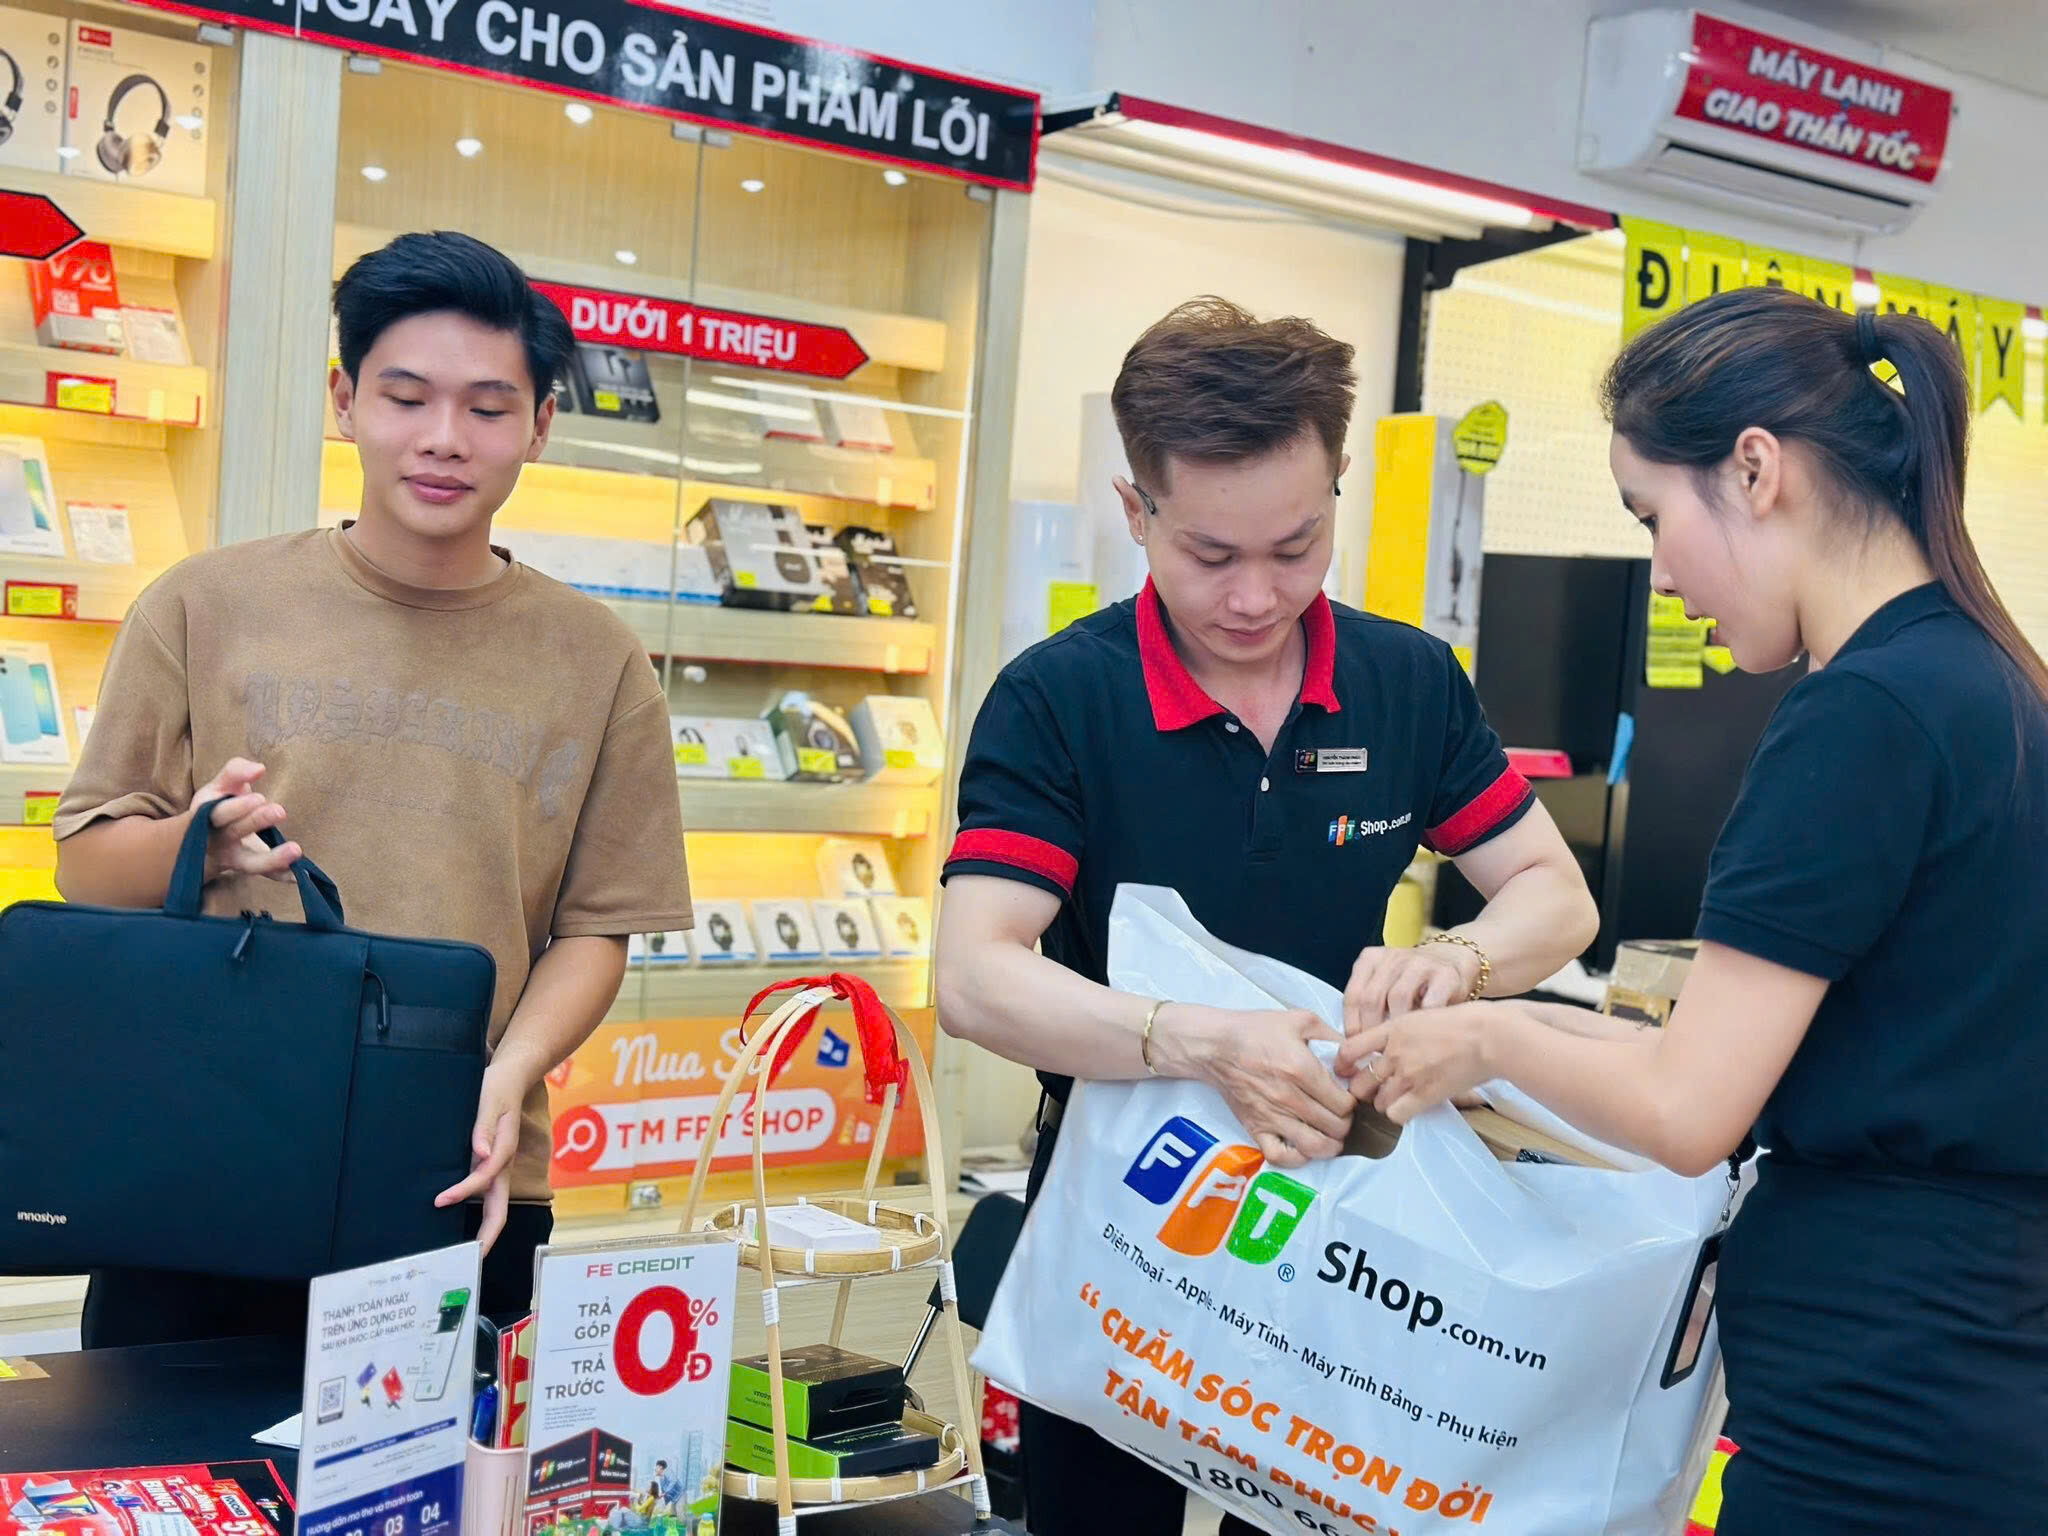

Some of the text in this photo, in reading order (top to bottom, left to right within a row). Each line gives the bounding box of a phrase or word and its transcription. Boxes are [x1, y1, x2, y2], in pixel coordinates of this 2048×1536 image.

[475, 0, 605, 75] CHO
[621, 30, 735, 104] SẢN
[911, 96, 990, 161] LỖI
[1748, 45, 1820, 90] MÁY
[1704, 88, 1782, 132] GIAO
[571, 297, 798, 366] DƯỚI 1 TRIỆU
[1328, 819, 1356, 842] FPT
[611, 1033, 705, 1087] Mua
[676, 1113, 733, 1141] FPT
[741, 1107, 825, 1137] SHOP
[1135, 1128, 1301, 1243] FPT
[586, 1256, 695, 1279] FE CREDIT
[323, 1305, 355, 1322] THANH
[385, 1291, 410, 1306] NGAY
[398, 1305, 417, 1320] EVO
[578, 1296, 613, 1318] TRẢ
[1316, 1241, 1548, 1370] Shop.com.vn
[574, 1321, 611, 1340] GÓP
[1102, 1222, 1130, 1255] Điện
[1130, 1242, 1165, 1284] Thoại
[1219, 1305, 1254, 1335] Máy
[1257, 1321, 1289, 1353] Tính
[1301, 1347, 1336, 1378] Máy
[1339, 1365, 1377, 1395] Tính
[1380, 1383, 1424, 1422] Bảng
[1437, 1410, 1474, 1442] Phụ
[1479, 1425, 1518, 1450] kiện
[571, 1353, 606, 1375] TRẢ
[545, 1379, 605, 1399] TRƯỚC
[1101, 1308, 1196, 1389] CHĂM
[1193, 1373, 1282, 1433] SÓC
[1284, 1414, 1402, 1497] TRỌN
[1102, 1367, 1169, 1430] TẬN
[1178, 1418, 1258, 1473] TÂM
[1183, 1459, 1284, 1509] 1800
[385, 1514, 404, 1534] 03
[421, 1502, 440, 1524] 04
